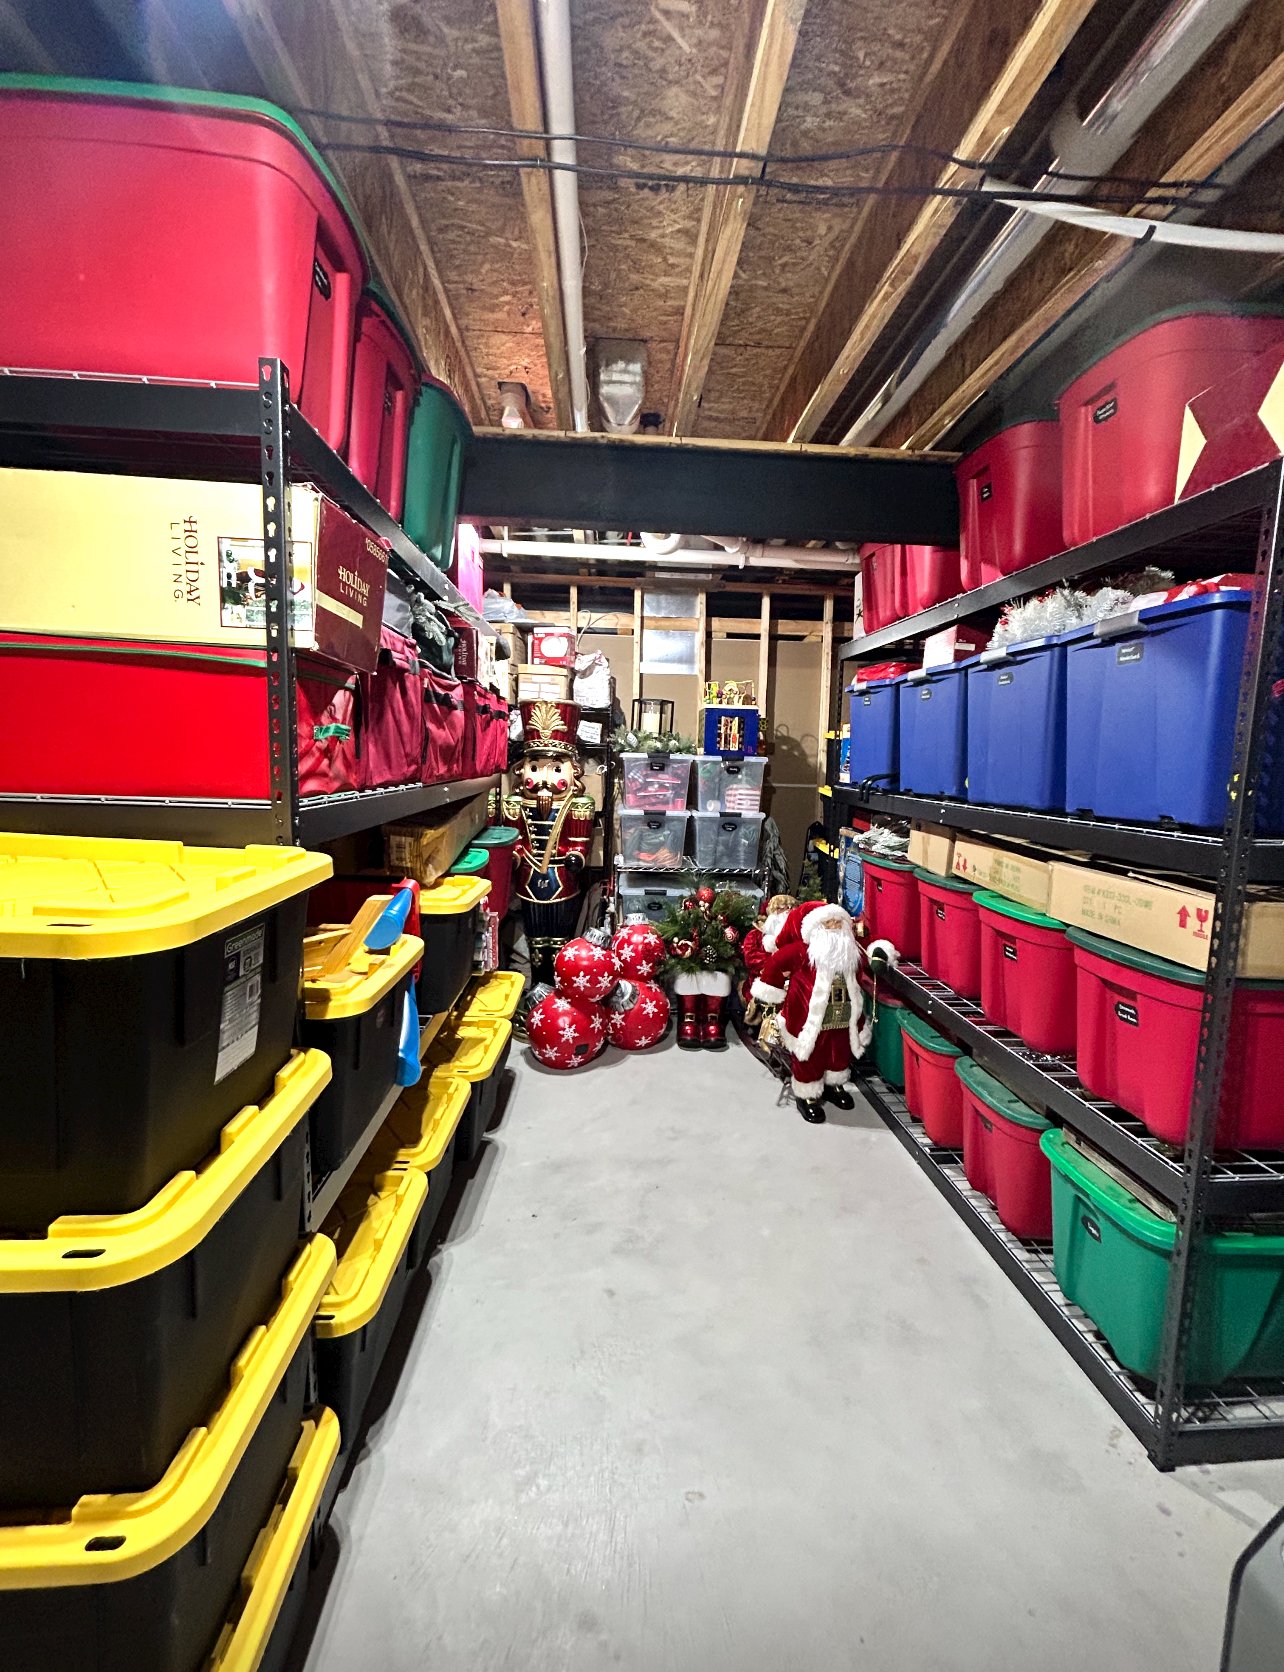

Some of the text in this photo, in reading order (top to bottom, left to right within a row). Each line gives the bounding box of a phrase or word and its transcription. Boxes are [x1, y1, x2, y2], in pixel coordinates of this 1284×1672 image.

[170, 522, 184, 601] LIVING
[183, 515, 204, 606] HOLIDAY
[338, 565, 370, 597] HOLIDAY
[340, 582, 368, 607] LIVING
[227, 928, 262, 953] Greenmade
